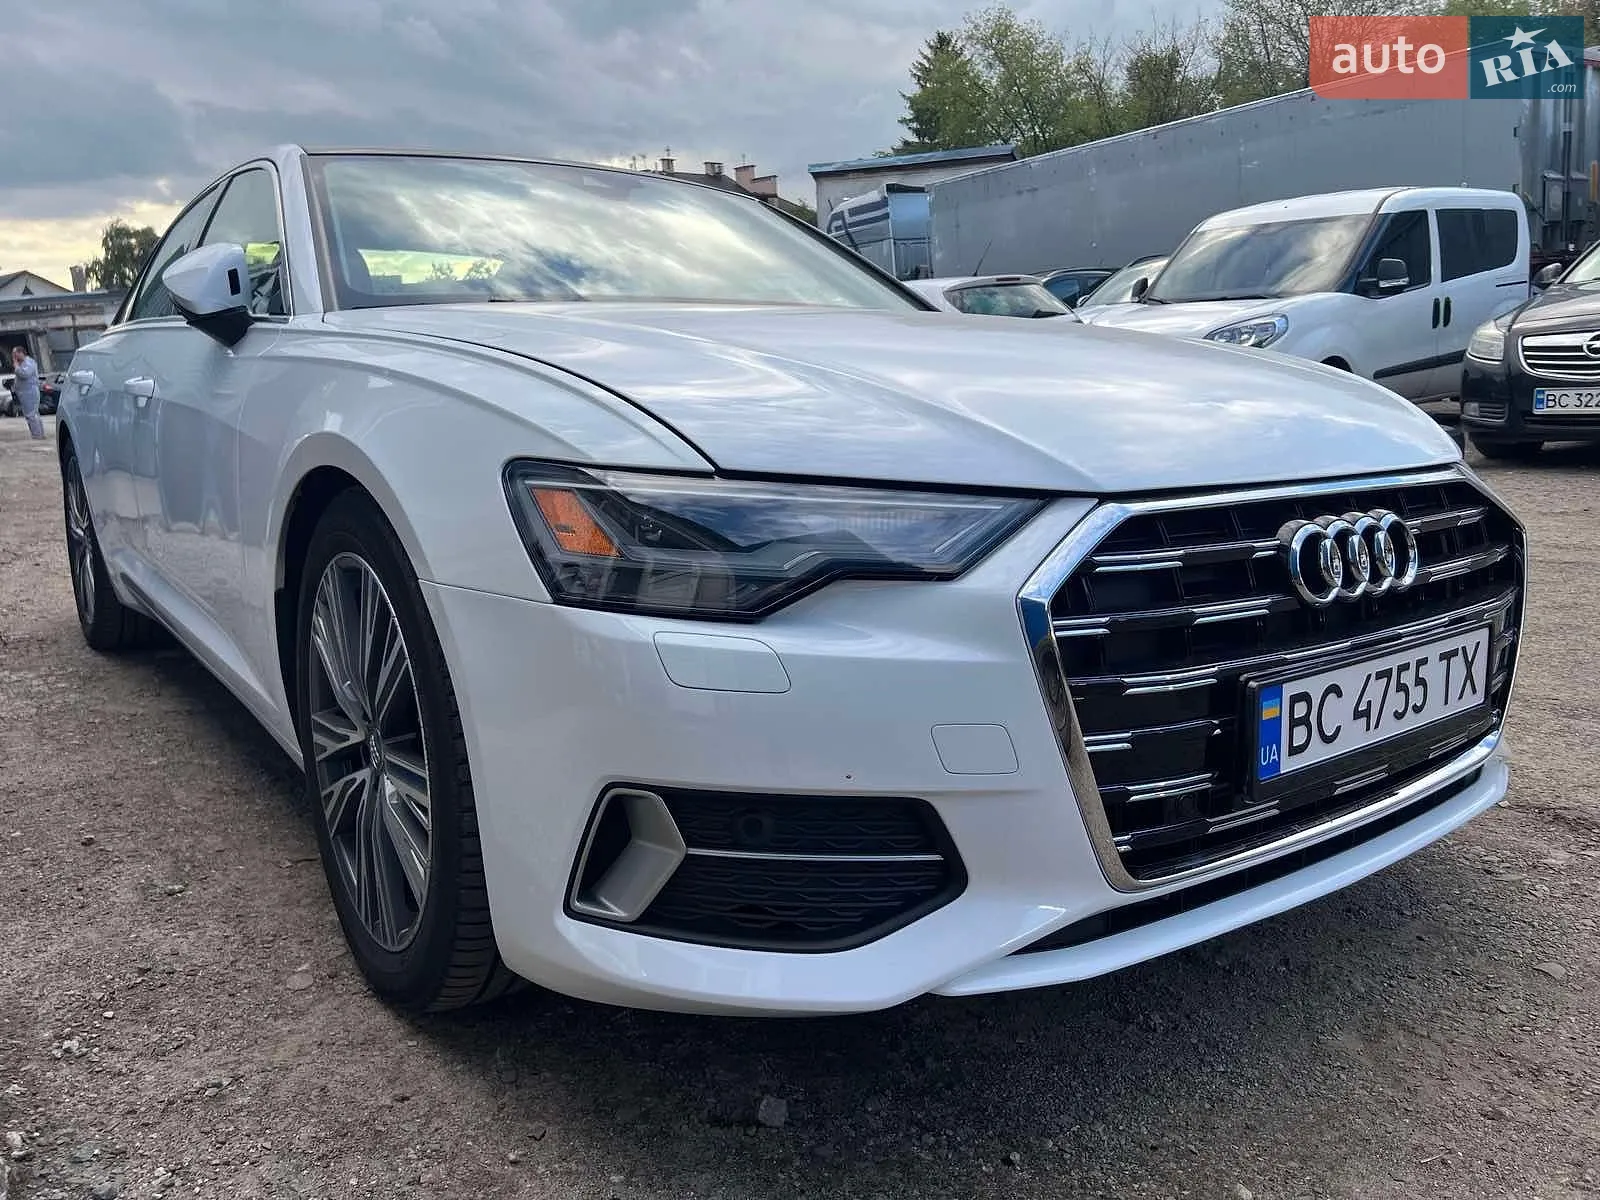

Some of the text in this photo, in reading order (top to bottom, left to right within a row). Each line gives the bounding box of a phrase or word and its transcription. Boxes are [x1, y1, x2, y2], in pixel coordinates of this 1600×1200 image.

[1546, 393, 1570, 408] BC
[1287, 641, 1481, 757] BC 4755 TX
[1261, 743, 1278, 766] UA
